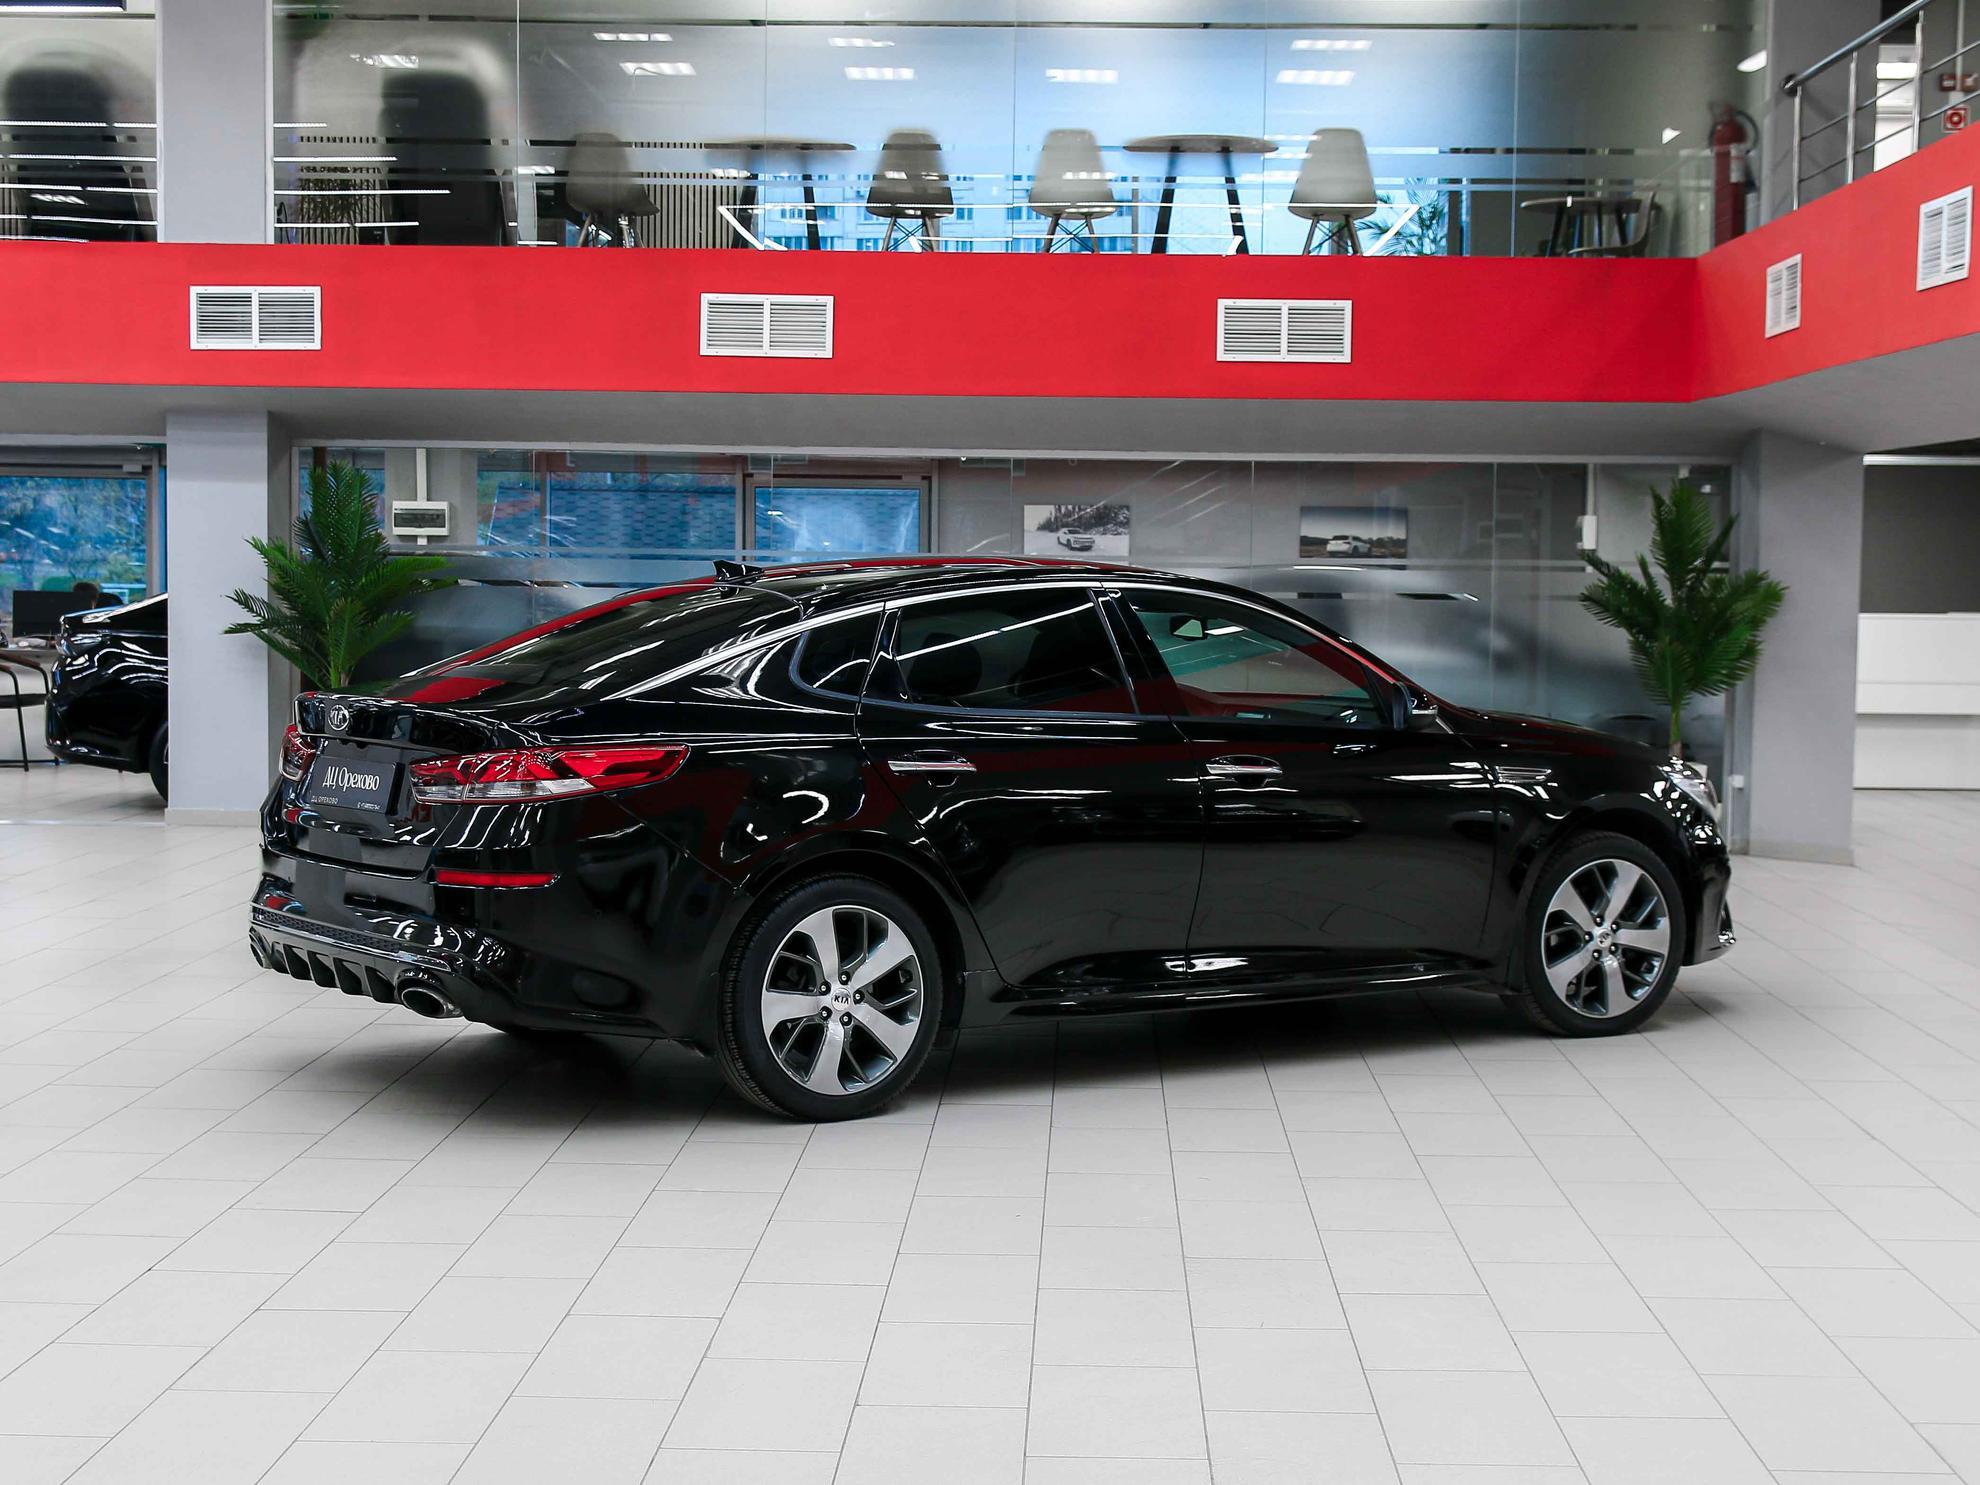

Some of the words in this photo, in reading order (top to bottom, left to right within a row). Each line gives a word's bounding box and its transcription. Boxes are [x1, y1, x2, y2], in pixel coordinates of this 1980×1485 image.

[329, 708, 347, 727] KIA
[322, 766, 339, 789] ДЦ
[338, 767, 380, 792] Орехово
[834, 994, 849, 1005] KIA
